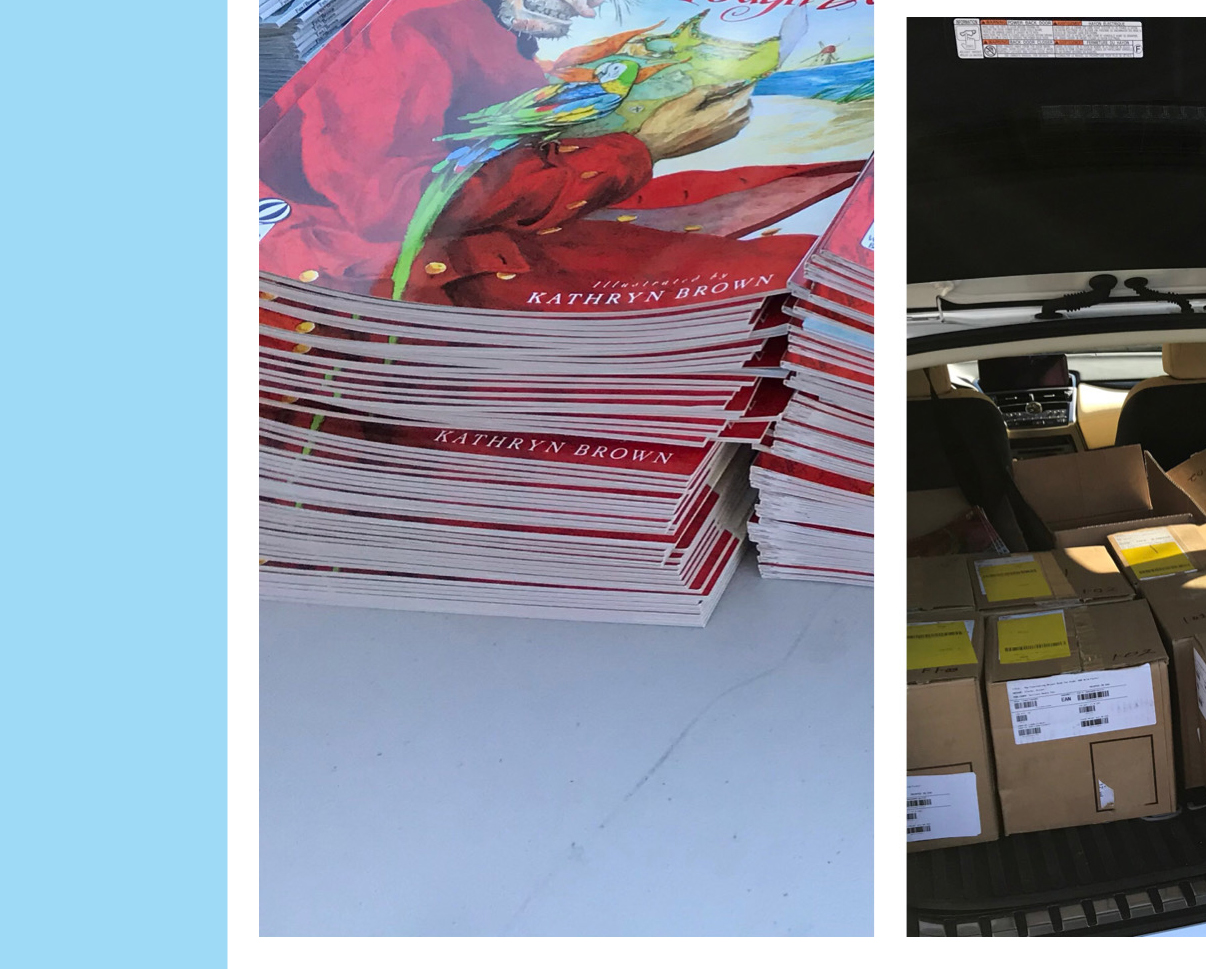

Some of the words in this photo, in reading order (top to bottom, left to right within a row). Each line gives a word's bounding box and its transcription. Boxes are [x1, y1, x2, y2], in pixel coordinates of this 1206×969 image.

[526, 289, 665, 306] KATHRYN
[674, 274, 775, 300] BROWN
[592, 274, 701, 289] Illustrated
[709, 271, 729, 280] by
[433, 430, 566, 454] KATHRYN
[573, 444, 674, 465] BROWN
